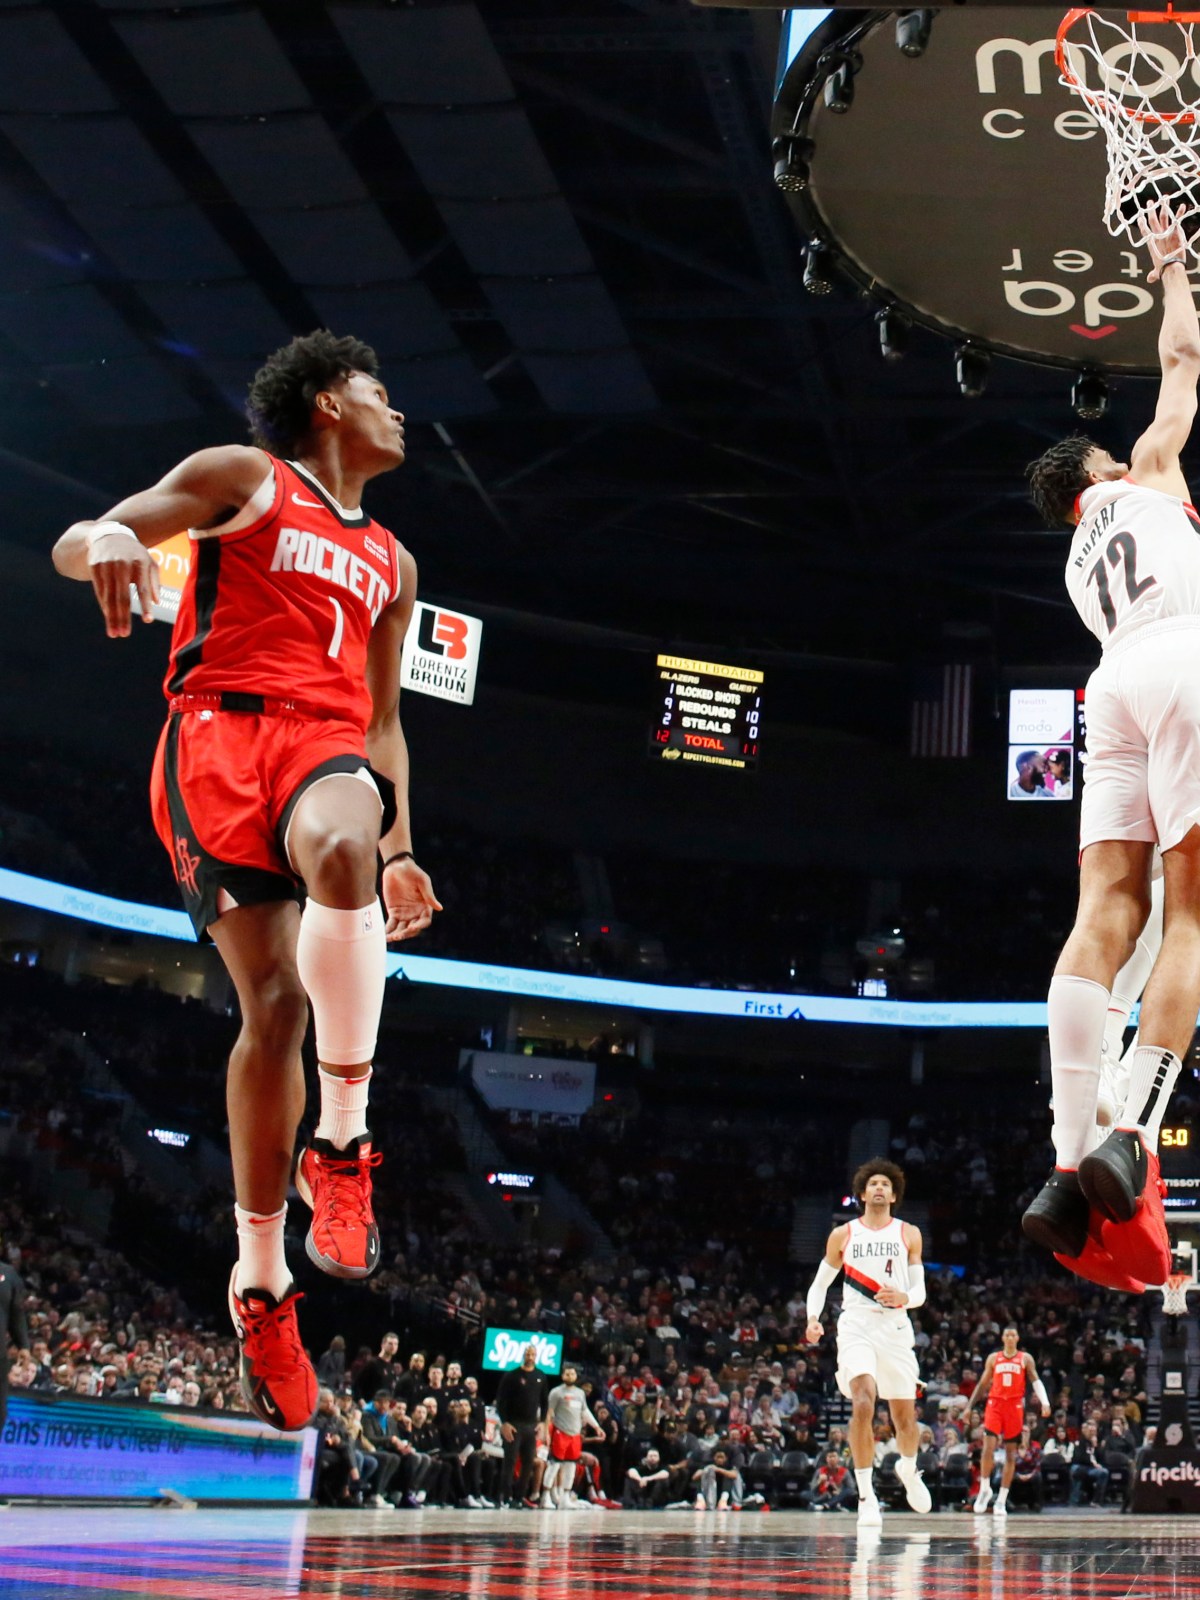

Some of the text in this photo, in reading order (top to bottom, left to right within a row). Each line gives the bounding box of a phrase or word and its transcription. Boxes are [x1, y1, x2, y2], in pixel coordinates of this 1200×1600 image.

[1074, 500, 1118, 568] RUPERT
[270, 527, 389, 628] ROCKETS
[1086, 531, 1157, 634] 72
[327, 596, 344, 659] 1
[412, 655, 467, 680] LORENTZ
[664, 656, 757, 681] HUSTLEBOARD
[410, 668, 466, 693] BRUUN
[661, 671, 758, 693] BLAZERS GUEST
[676, 685, 714, 701] BLOCKED
[715, 691, 741, 706] SHOTS
[665, 697, 759, 724] 9 REBOUNDS 10
[662, 712, 758, 739] 2 STEALS 0
[1017, 720, 1052, 732] moda
[657, 730, 670, 742] 12
[684, 734, 724, 750] TOTAL
[744, 1001, 783, 1015] First
[1161, 1129, 1188, 1146] 5.0
[1165, 1178, 1200, 1188] TISSOT
[853, 1242, 900, 1259] BLAZERS
[885, 1259, 893, 1278] 4
[3, 1420, 41, 1446] ans
[44, 1422, 94, 1449] more
[97, 1423, 114, 1450] to
[117, 1423, 163, 1453] cheer
